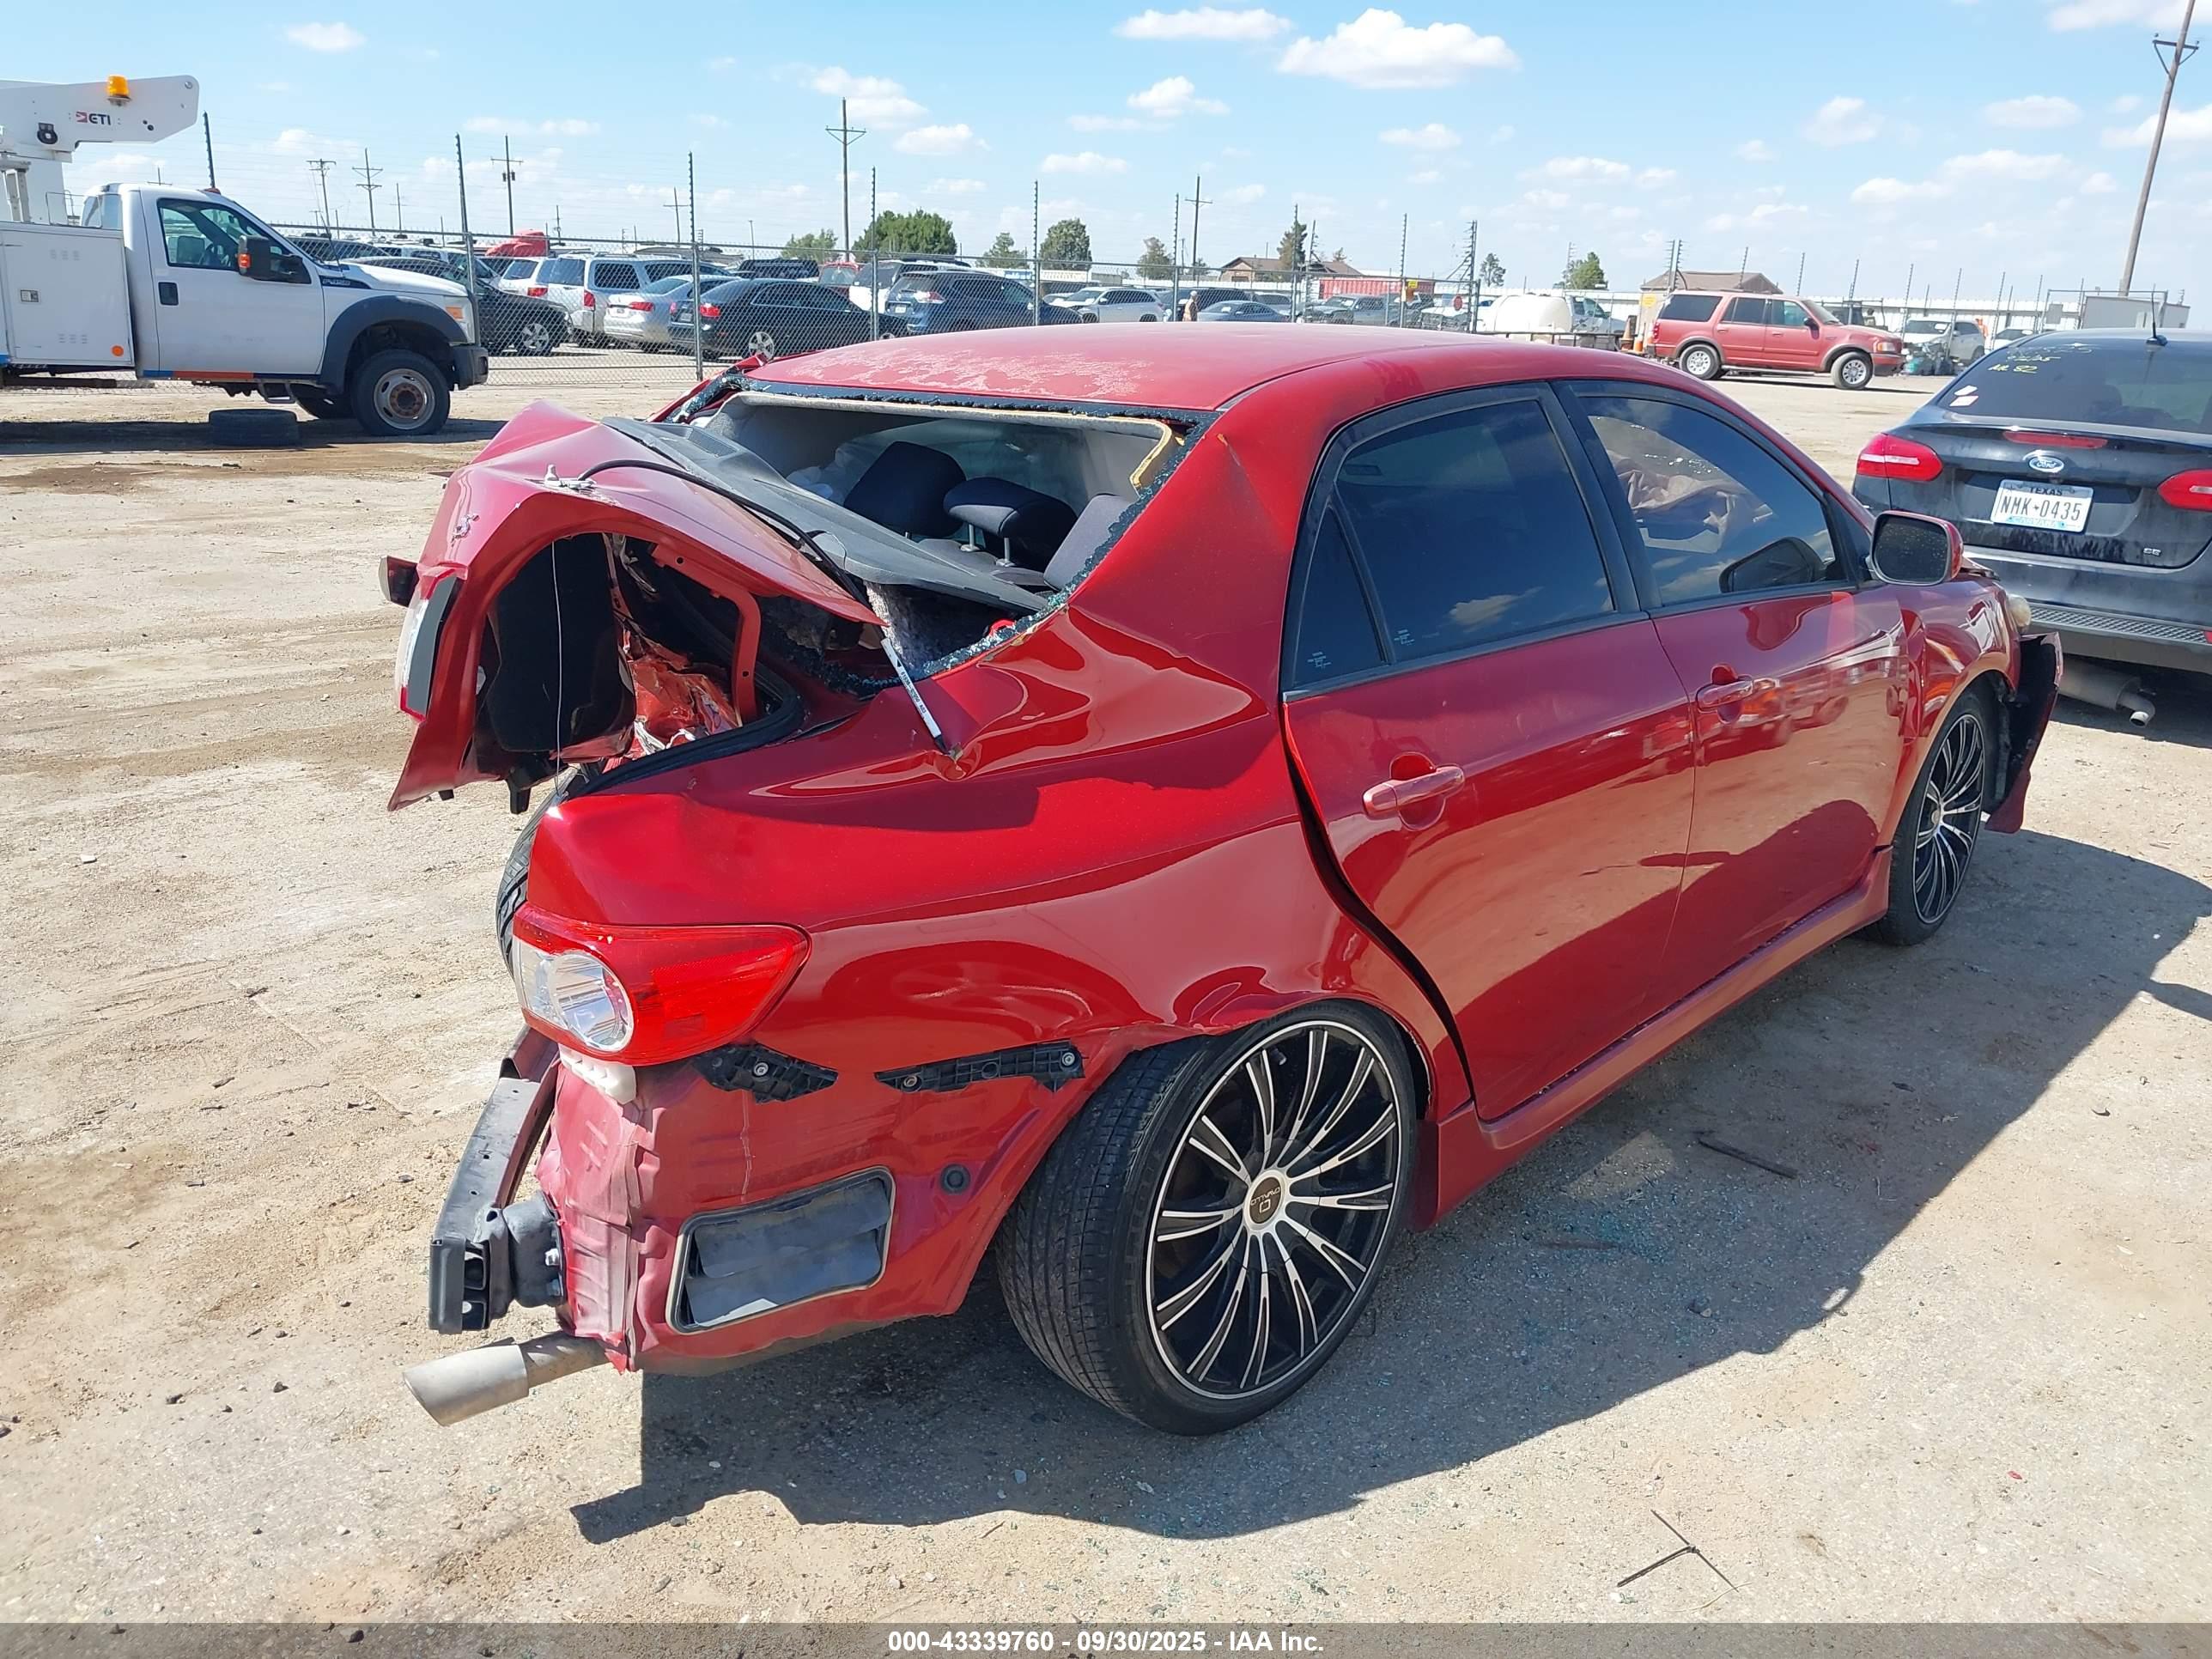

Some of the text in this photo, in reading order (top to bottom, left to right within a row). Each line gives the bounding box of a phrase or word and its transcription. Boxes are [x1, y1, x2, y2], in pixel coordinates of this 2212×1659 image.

[88, 113, 112, 125] ETI
[2029, 487, 2063, 496] TEXAS
[1250, 1187, 1280, 1206] CAVALLO
